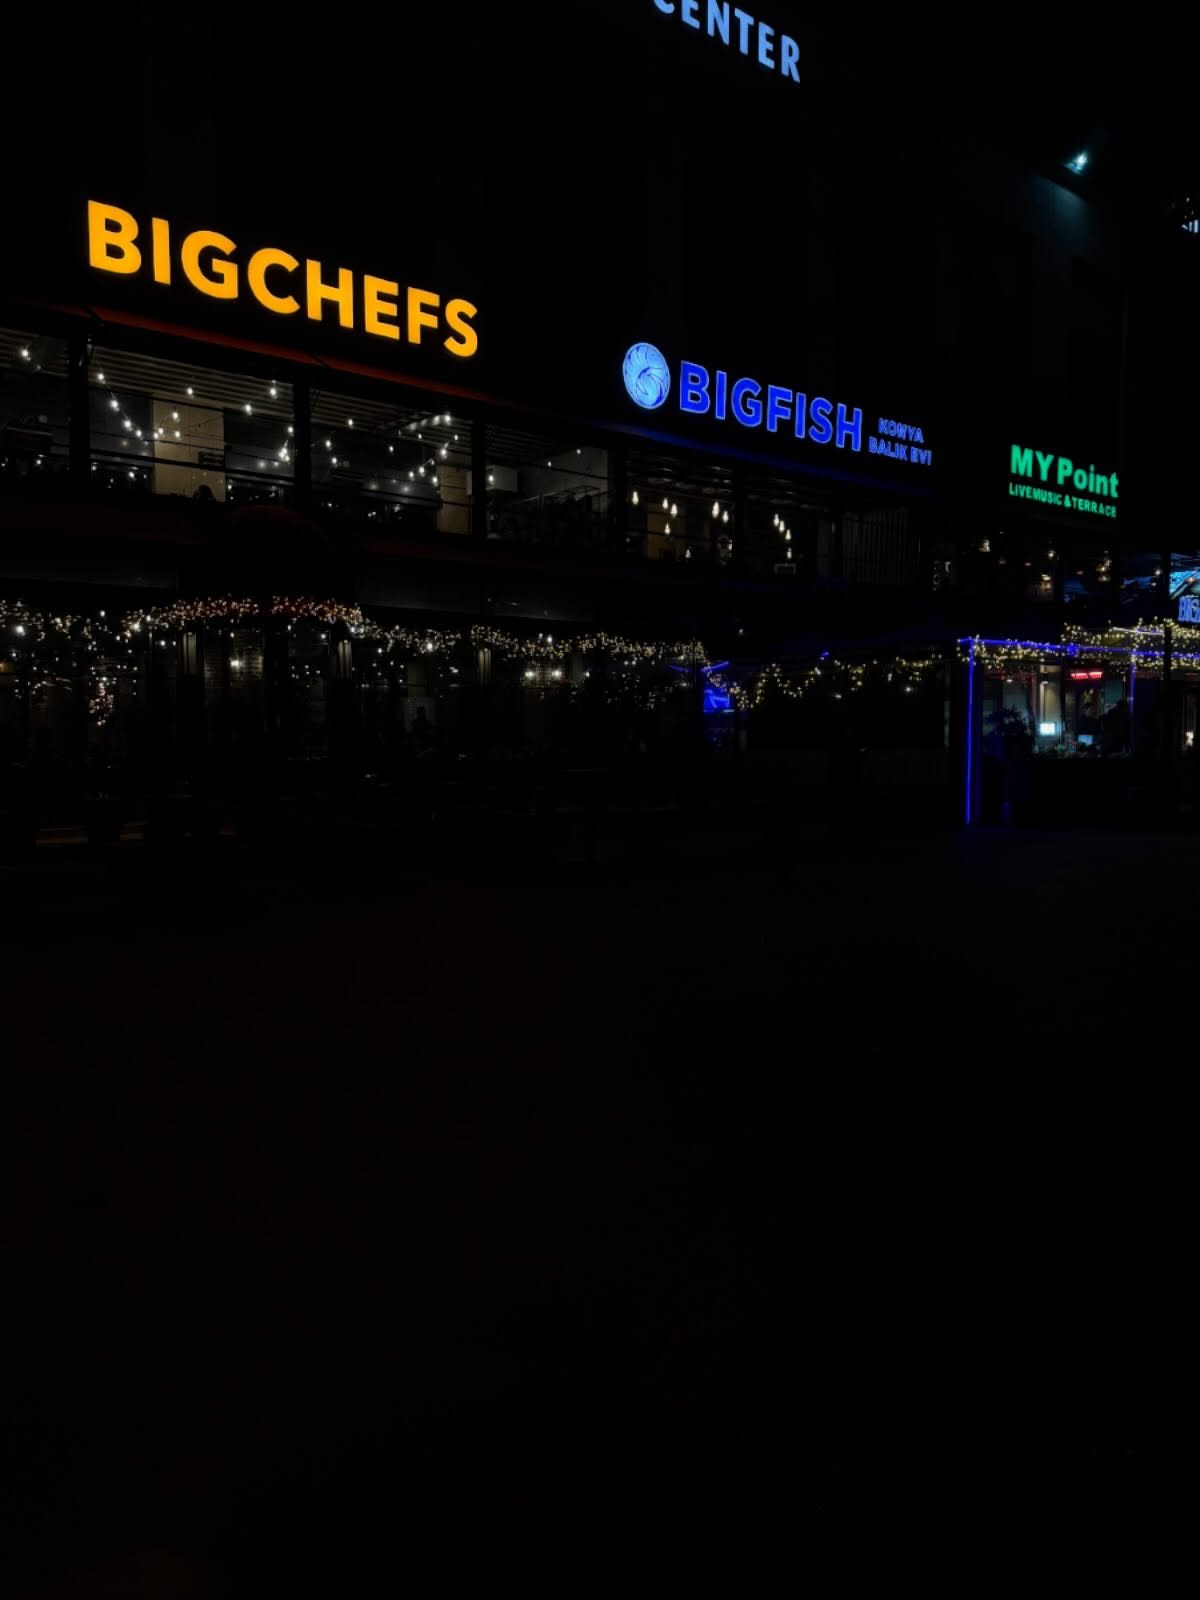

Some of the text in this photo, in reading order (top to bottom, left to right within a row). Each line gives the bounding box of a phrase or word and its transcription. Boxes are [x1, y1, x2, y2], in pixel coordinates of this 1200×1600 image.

[86, 199, 479, 359] BIGCHEFS
[679, 360, 863, 453] BIGFISH
[868, 436, 908, 461] BALIK
[879, 417, 924, 443] KONYA
[1010, 444, 1119, 498] MY Point
[1071, 496, 1117, 518] TERRACE
